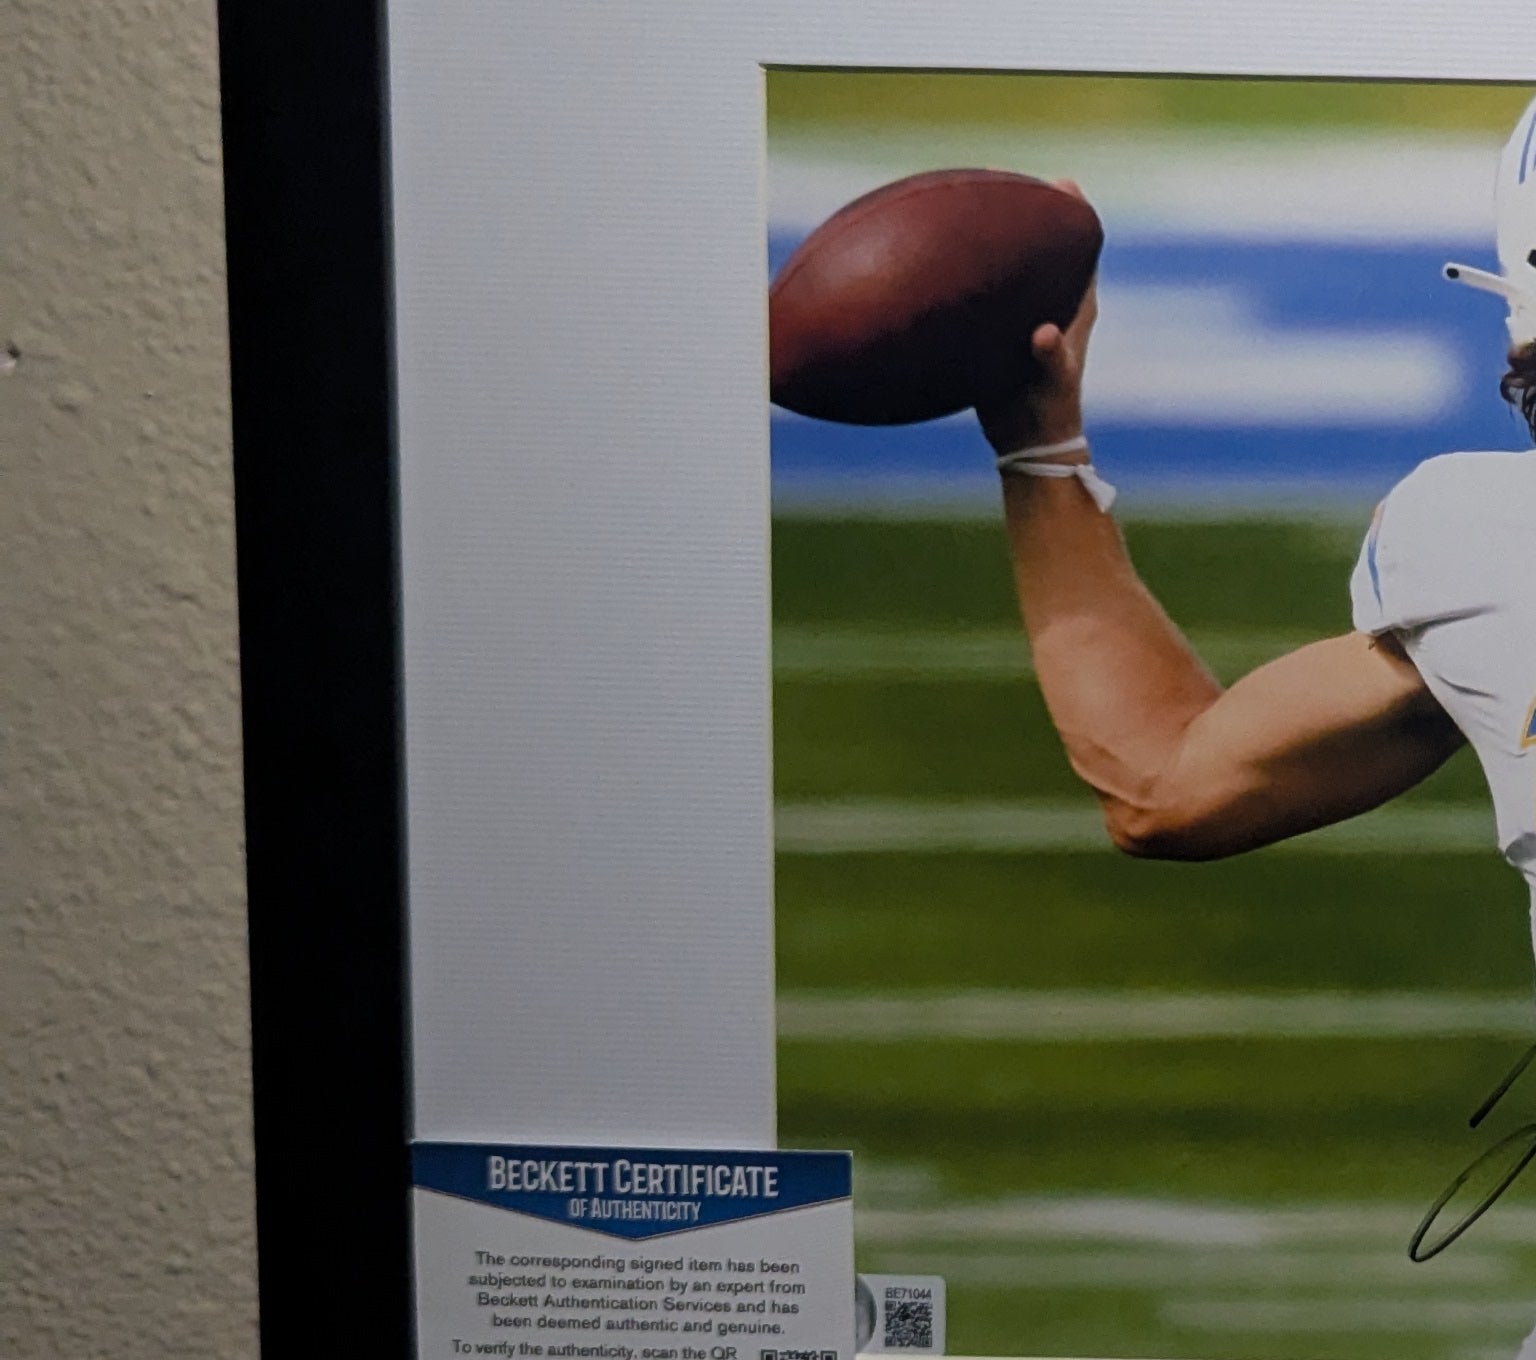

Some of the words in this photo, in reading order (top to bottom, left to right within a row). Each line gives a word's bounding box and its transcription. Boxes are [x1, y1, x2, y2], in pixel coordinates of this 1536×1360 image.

[488, 1155, 609, 1193] BECKETT
[614, 1159, 779, 1198] CERTIFICATE
[590, 1197, 702, 1222] AUTHENTICITY
[475, 1251, 505, 1265] The
[510, 1254, 625, 1273] corresponding
[630, 1256, 683, 1273] signed
[689, 1258, 722, 1271] item
[728, 1258, 755, 1273] has
[760, 1259, 800, 1274] been
[468, 1272, 546, 1290] subjected
[552, 1274, 567, 1288] to
[572, 1276, 664, 1291] examination
[670, 1277, 688, 1295] by
[693, 1280, 712, 1292] an
[716, 1281, 764, 1296] expert
[770, 1280, 806, 1294] from
[886, 1287, 932, 1299] BE71044
[477, 1291, 538, 1307] Beckett
[544, 1294, 658, 1311] Authentication
[663, 1296, 731, 1313] Services
[736, 1299, 766, 1313] and
[771, 1300, 799, 1314] has
[493, 1312, 532, 1328] been
[537, 1314, 600, 1330] deemed
[605, 1316, 678, 1332] authentic
[683, 1319, 712, 1333] and
[717, 1320, 785, 1336] genuine.
[452, 1339, 472, 1354] To
[476, 1341, 516, 1358] verify
[519, 1342, 543, 1356] the
[642, 1347, 678, 1360] scan
[682, 1346, 706, 1360] the
[711, 1346, 737, 1360] QR
